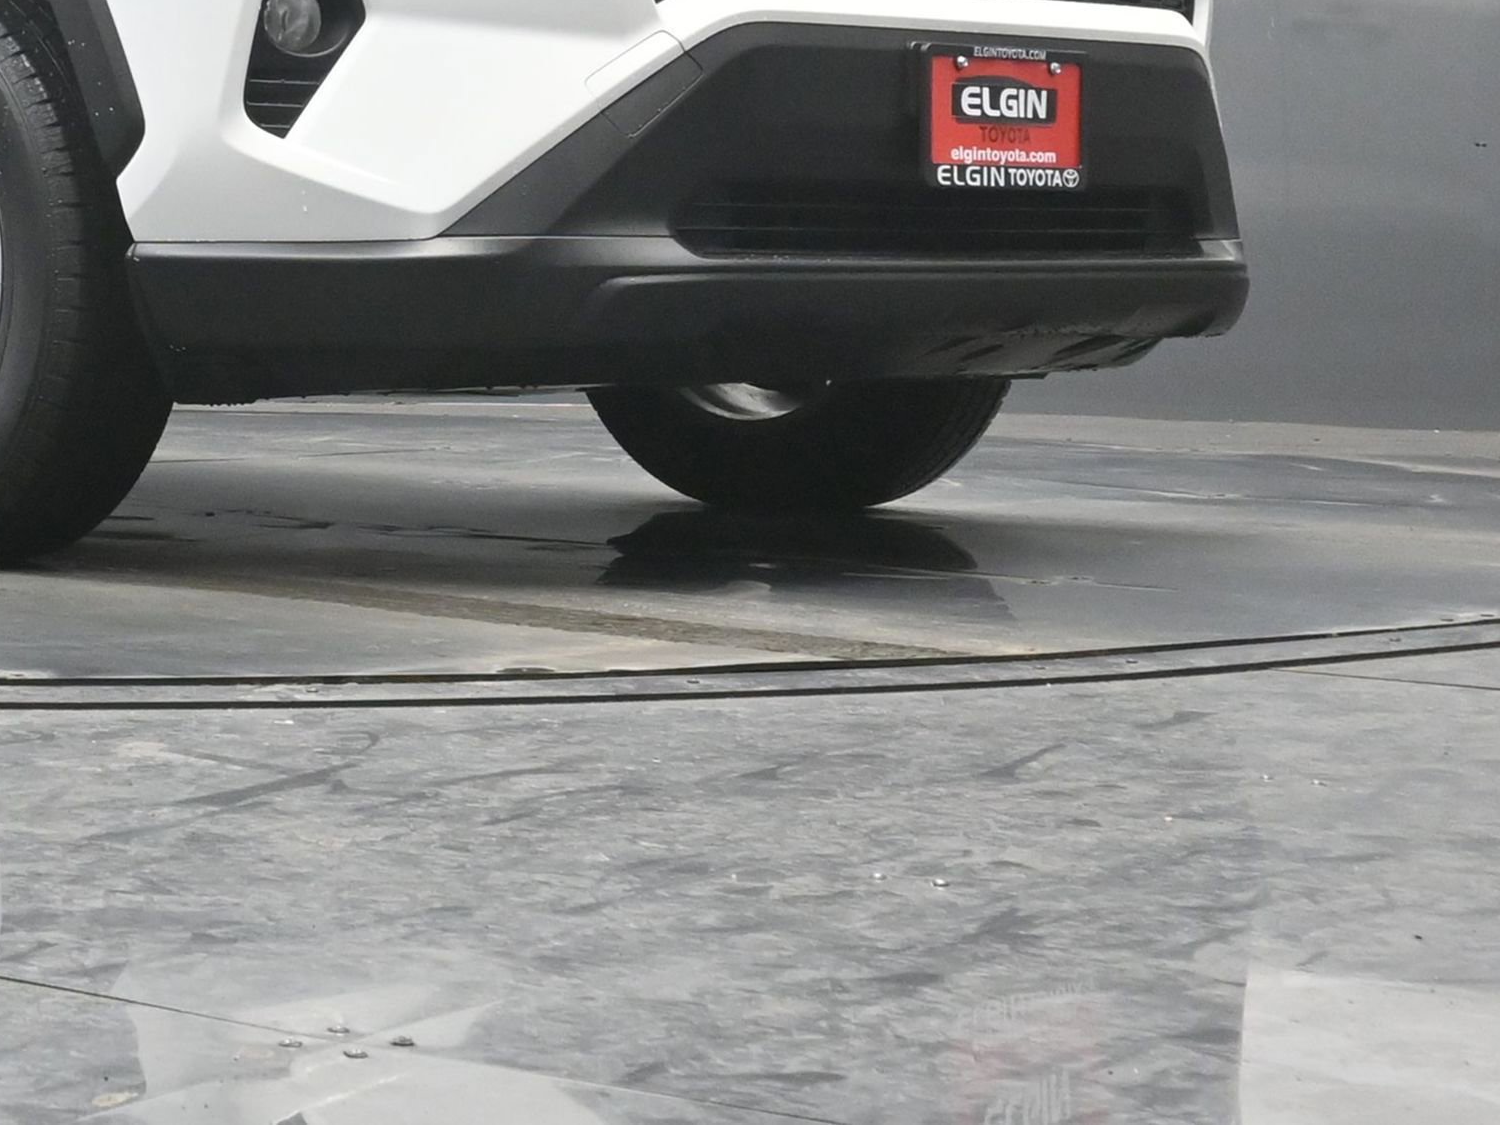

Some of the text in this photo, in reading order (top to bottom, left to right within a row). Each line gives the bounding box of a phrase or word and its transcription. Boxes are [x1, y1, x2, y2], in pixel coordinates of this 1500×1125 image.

[974, 46, 1047, 60] ELGINTOYOTA.COM
[960, 85, 1048, 119] ELGIN
[981, 126, 1031, 144] TOYOTA
[950, 146, 1057, 164] elgintoyota.com
[937, 165, 1063, 187] ELGIN TOYOTA
